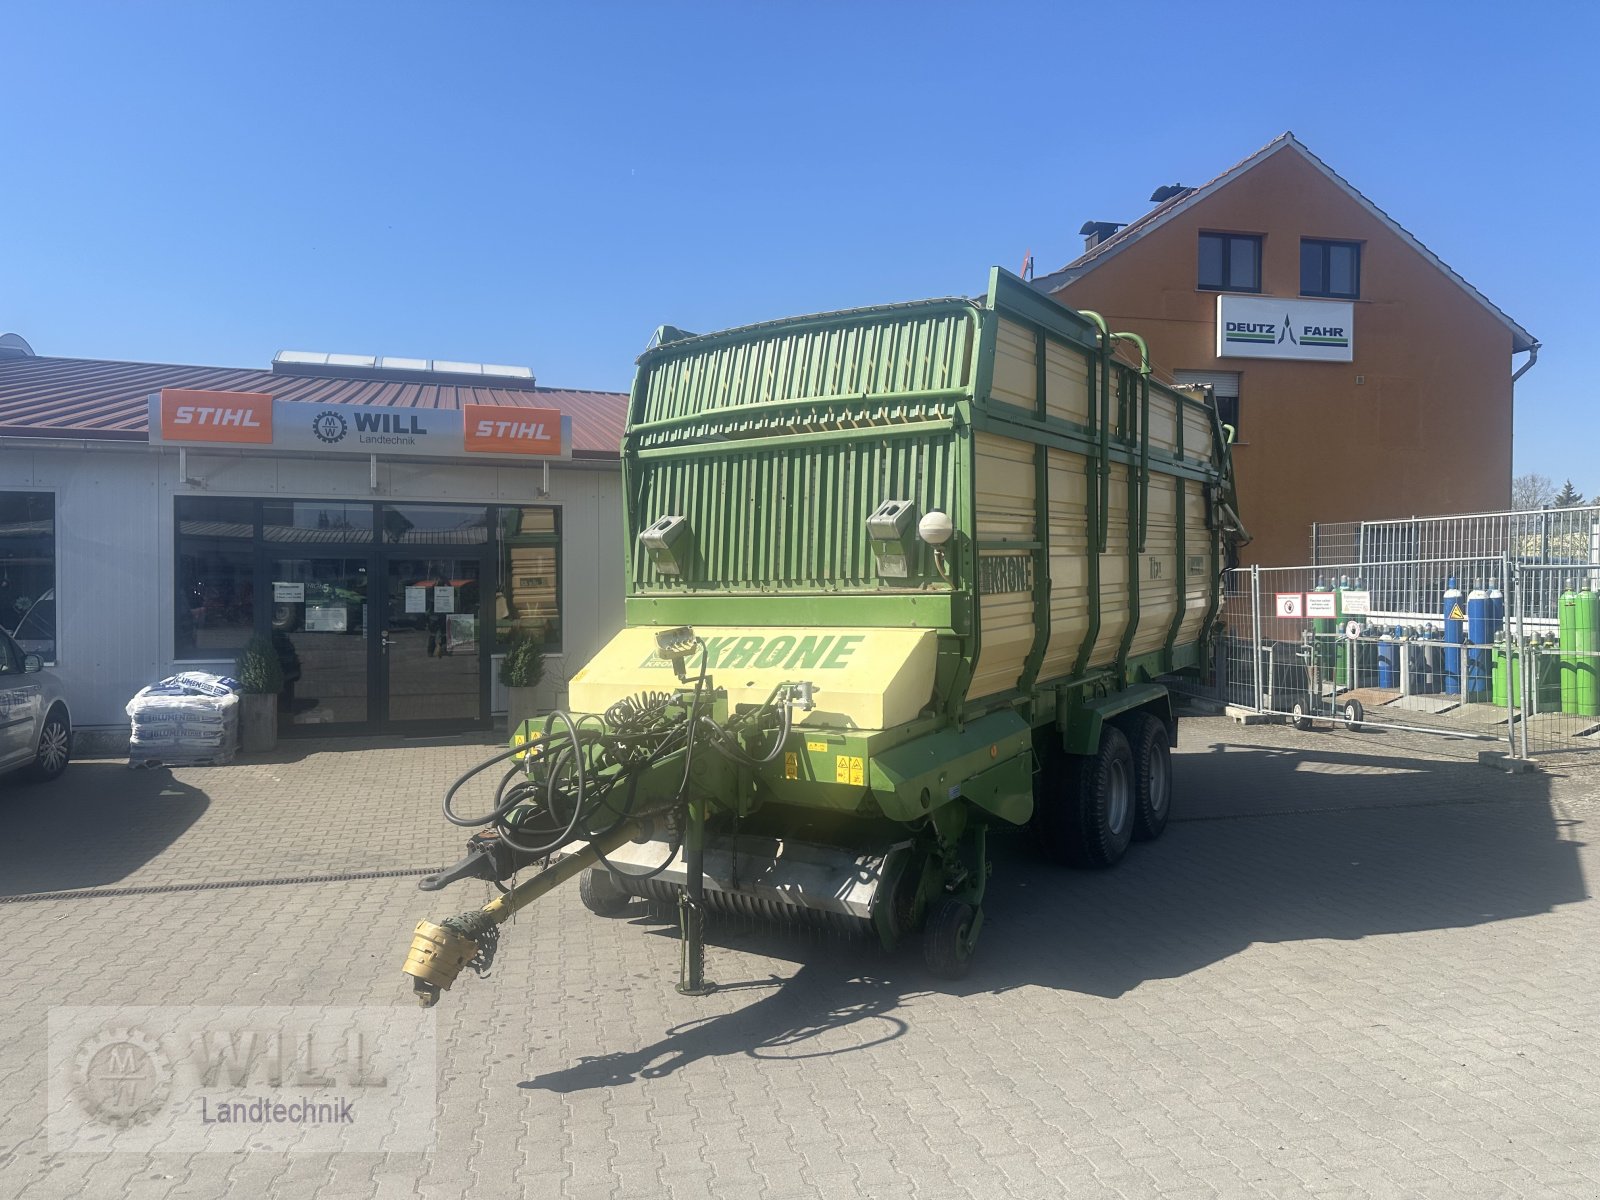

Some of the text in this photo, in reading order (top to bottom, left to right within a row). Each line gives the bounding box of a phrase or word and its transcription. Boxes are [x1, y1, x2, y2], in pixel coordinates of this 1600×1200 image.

[1226, 321, 1344, 337] DEUTZ FAHR
[174, 406, 260, 427] STIHL
[354, 412, 427, 434] WILL
[359, 434, 415, 446] Landtechnik
[475, 420, 551, 440] STIHL
[689, 635, 866, 669] KRONE
